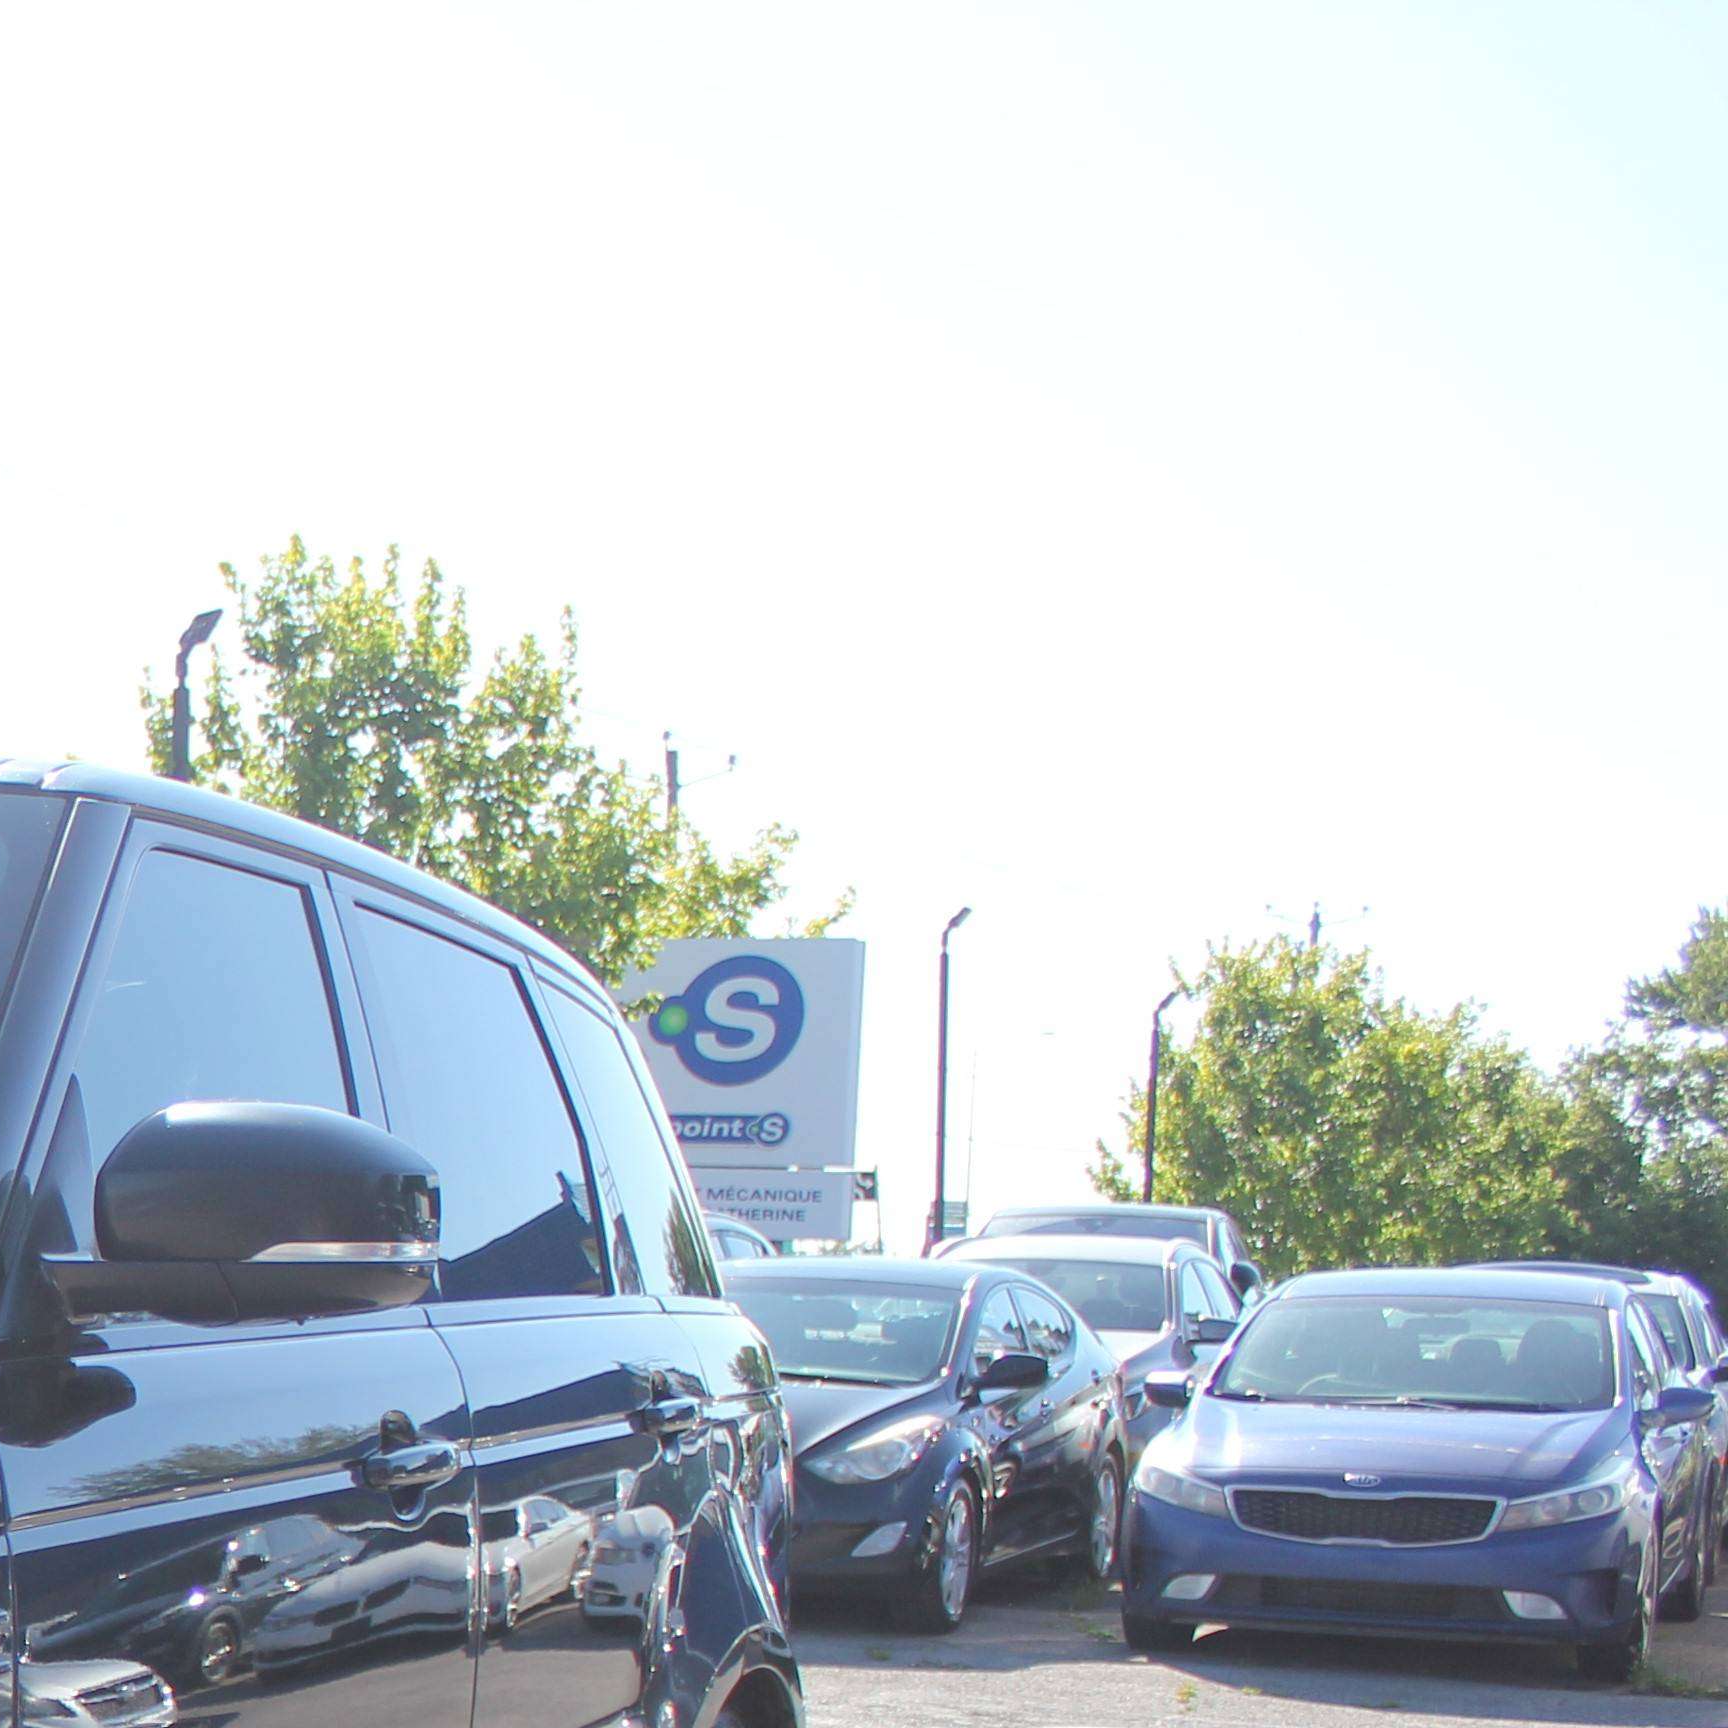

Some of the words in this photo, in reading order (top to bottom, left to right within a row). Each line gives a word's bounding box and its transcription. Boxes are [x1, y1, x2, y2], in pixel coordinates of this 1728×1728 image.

[695, 976, 779, 1063] S
[707, 1186, 823, 1203] MÉCANIQUE
[717, 1206, 806, 1222] THERINE
